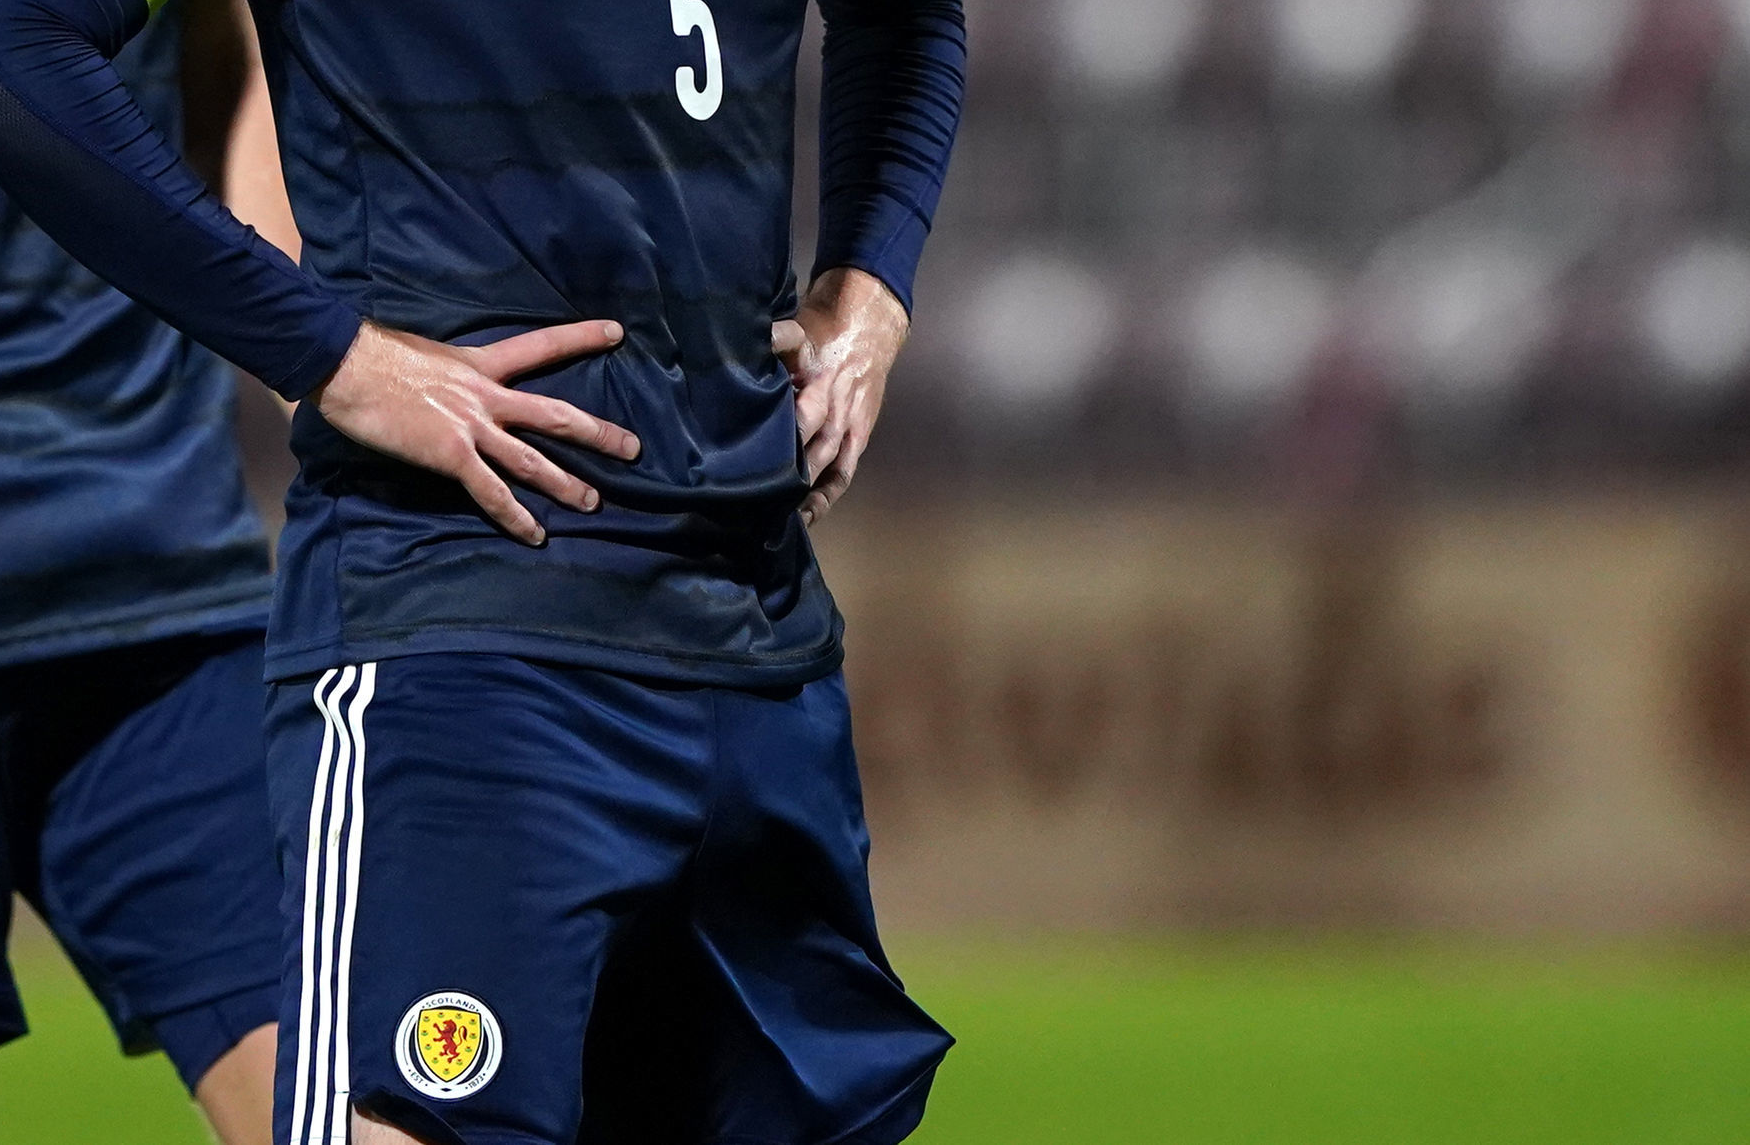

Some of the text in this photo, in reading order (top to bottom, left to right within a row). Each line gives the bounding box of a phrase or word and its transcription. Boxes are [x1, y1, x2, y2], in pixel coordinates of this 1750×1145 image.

[425, 997, 476, 1011] SCOTLAND
[410, 1071, 425, 1084] EST
[467, 1074, 485, 1089] 1873
